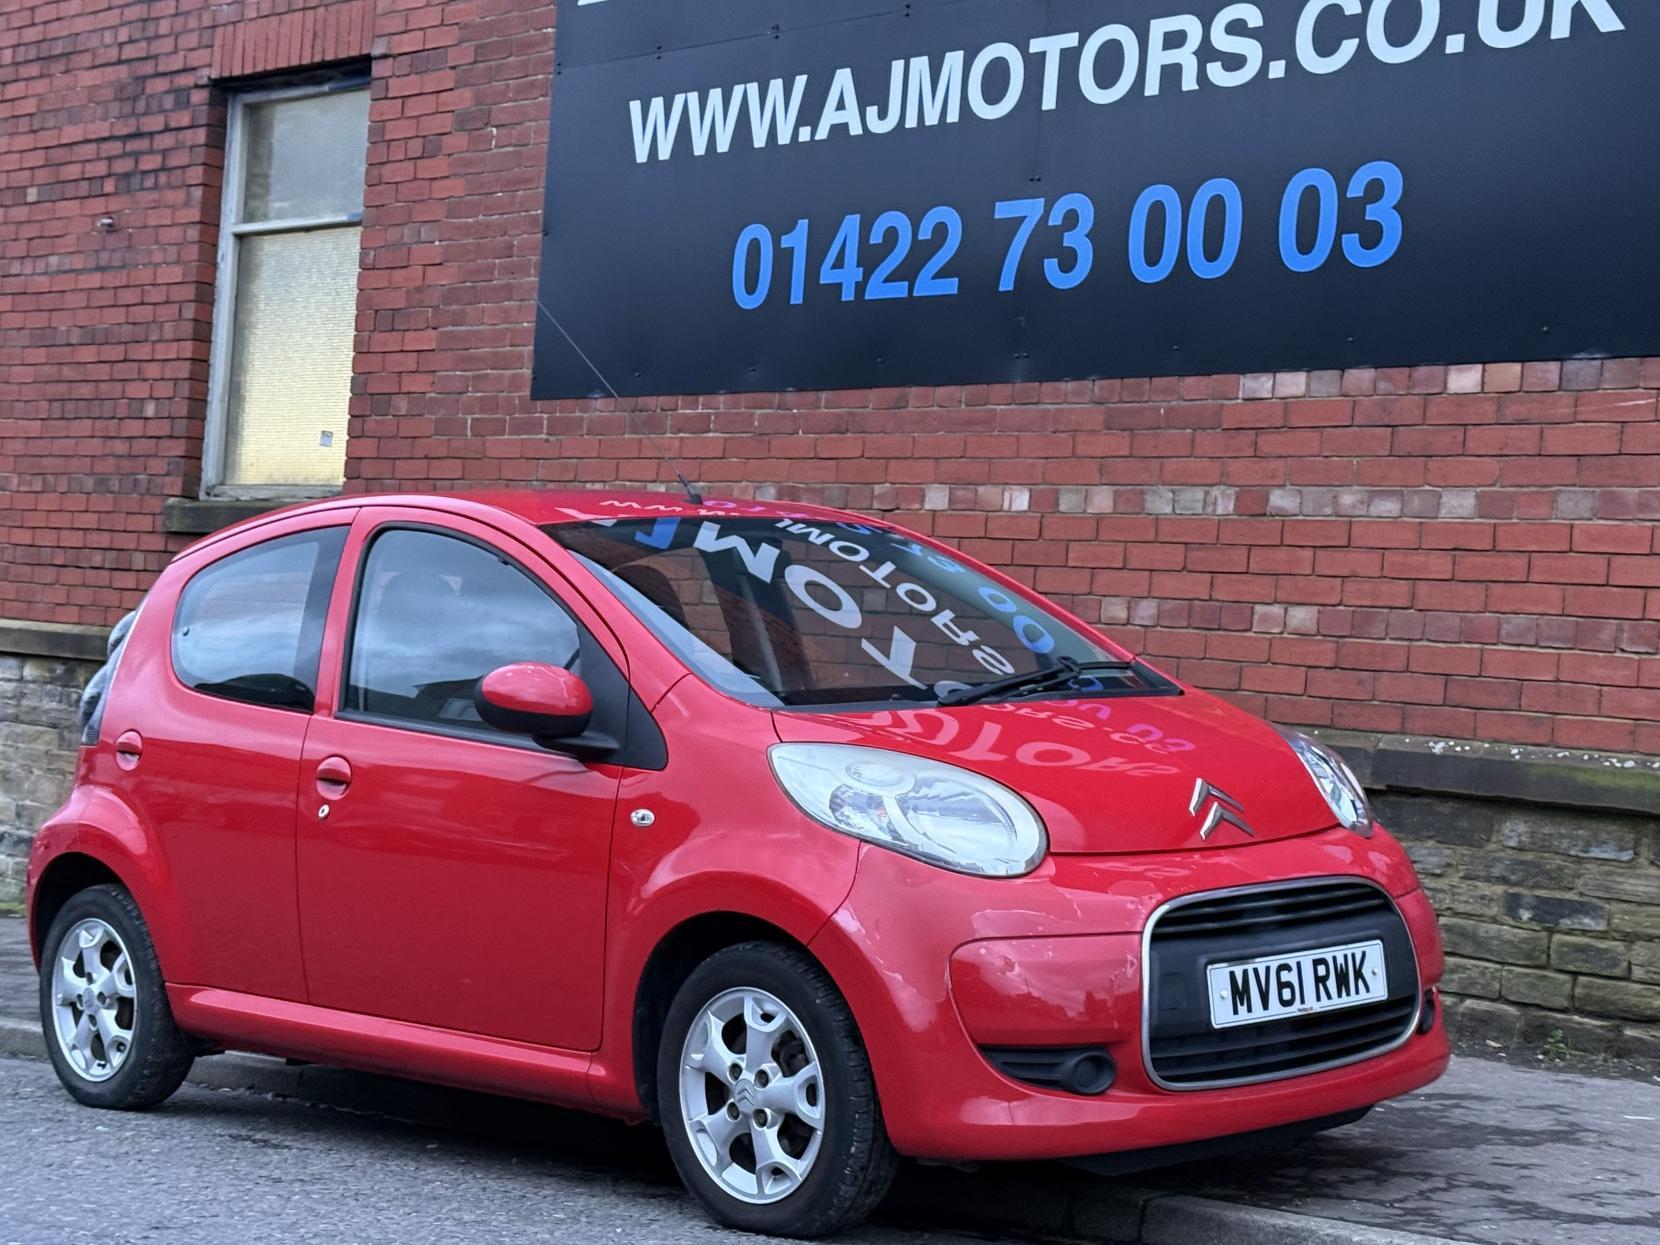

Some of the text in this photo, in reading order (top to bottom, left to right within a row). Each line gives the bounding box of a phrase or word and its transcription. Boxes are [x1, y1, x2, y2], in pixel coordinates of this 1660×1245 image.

[731, 160, 1405, 311] 01422 73 00 03
[1229, 950, 1372, 1016] MV61 RWK
